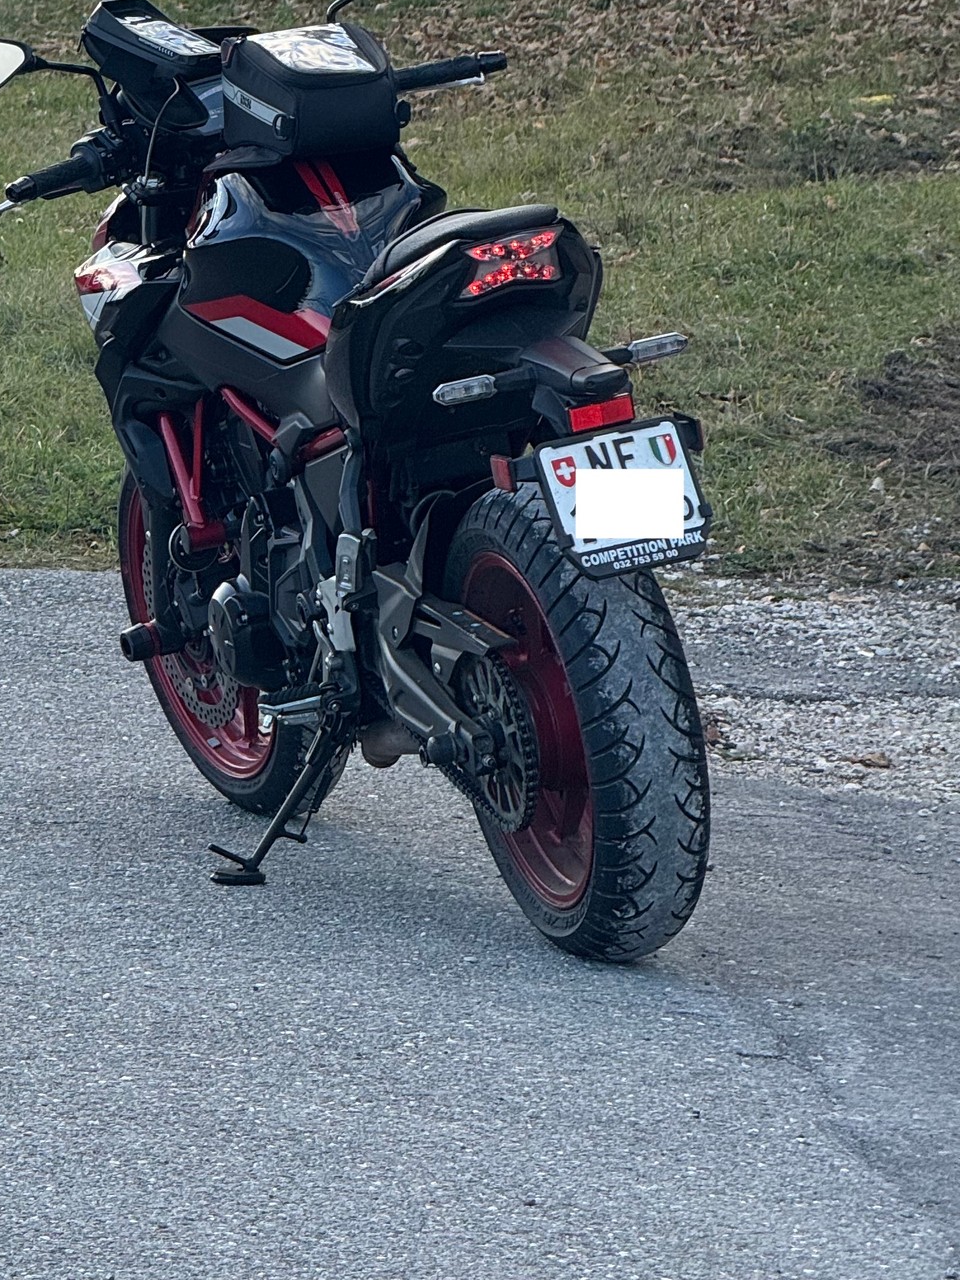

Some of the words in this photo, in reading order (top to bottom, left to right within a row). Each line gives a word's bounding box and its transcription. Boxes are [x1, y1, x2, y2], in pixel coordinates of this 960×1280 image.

[584, 436, 634, 469] NF
[581, 540, 667, 567] COMPETITION
[670, 531, 705, 548] PARK
[613, 560, 632, 569] 032
[633, 555, 651, 565] 753
[652, 551, 665, 561] 59
[666, 548, 679, 558] 00
